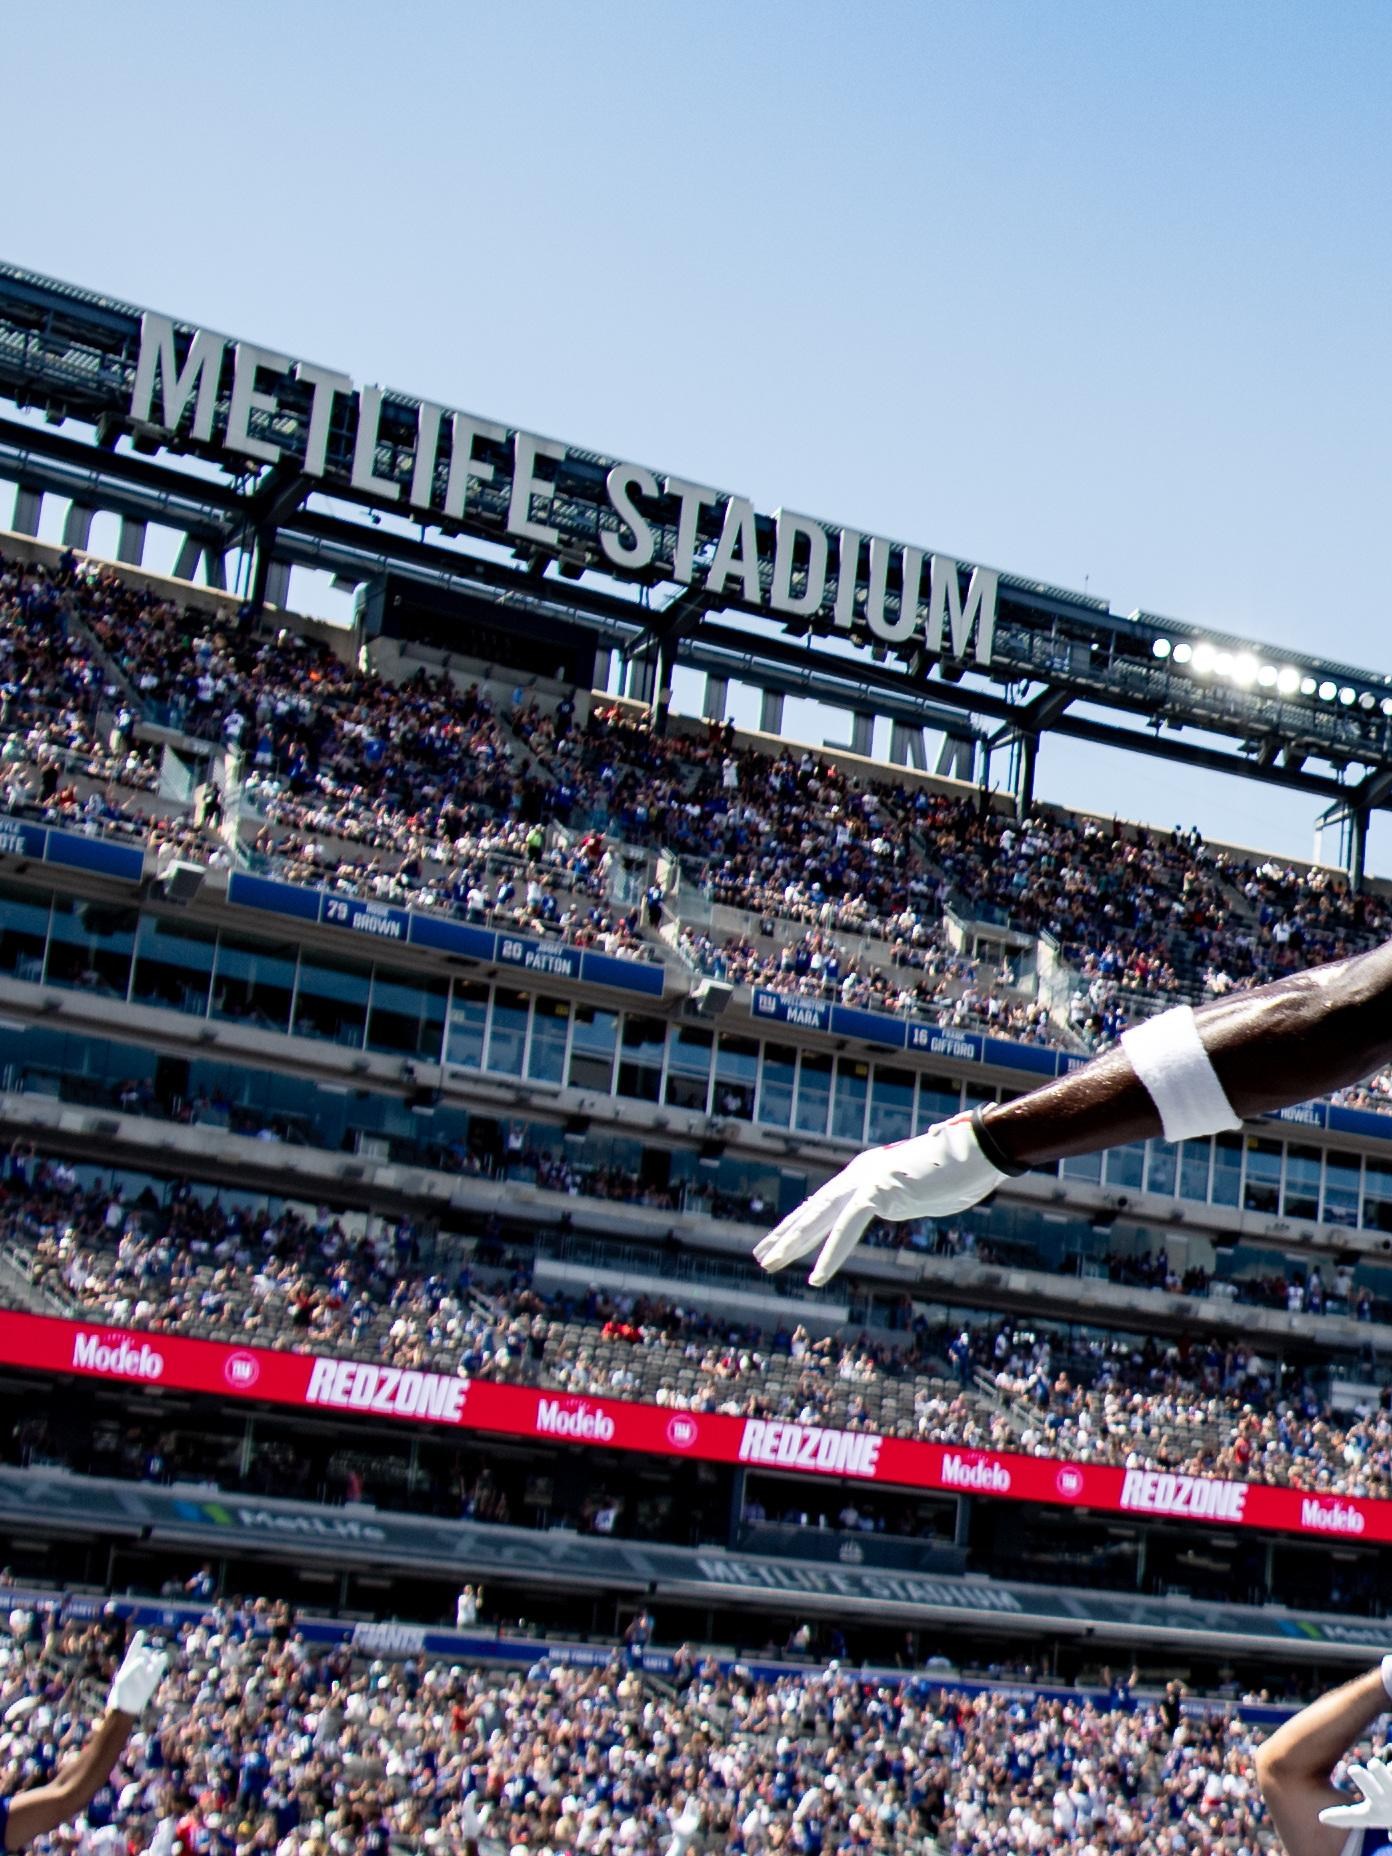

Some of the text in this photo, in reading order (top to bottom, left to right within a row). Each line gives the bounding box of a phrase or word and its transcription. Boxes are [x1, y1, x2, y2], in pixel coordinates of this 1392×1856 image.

[130, 312, 566, 546] METLIFE
[599, 464, 999, 667] STADIUM
[0, 832, 26, 855] OTE
[352, 911, 401, 938] BROWN
[525, 951, 572, 977] PATTON
[786, 1006, 820, 1028] MARA
[930, 1037, 975, 1059] GIFFORD
[73, 1331, 164, 1380] Modelo
[305, 1356, 471, 1423] REDZONE
[536, 1398, 615, 1442] Modelo
[738, 1417, 883, 1478] REDZONE
[941, 1453, 1012, 1493] Modelo
[1120, 1468, 1249, 1523] REDZONE
[1301, 1498, 1365, 1535] Modelo
[695, 1557, 1023, 1613] METLIFE STADIUM
